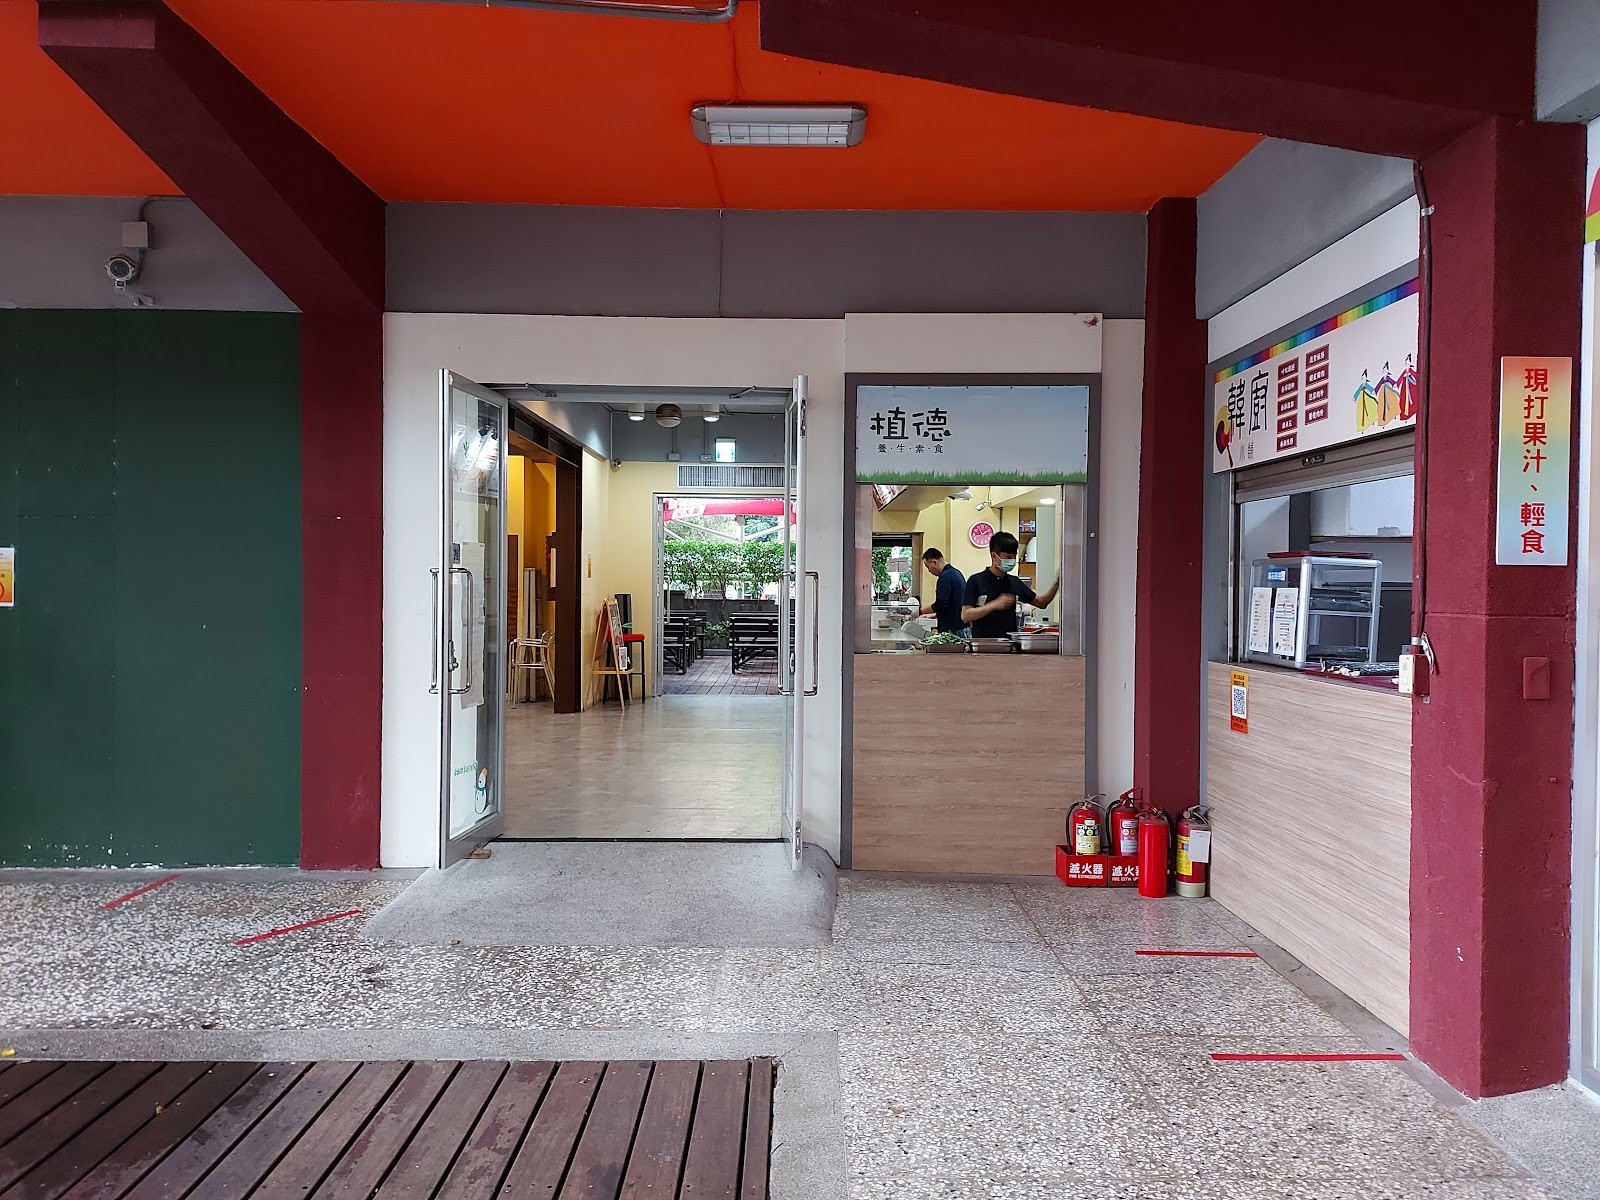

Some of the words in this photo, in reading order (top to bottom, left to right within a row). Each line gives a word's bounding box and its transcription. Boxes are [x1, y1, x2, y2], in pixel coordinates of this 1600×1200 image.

[869, 406, 952, 442] 植德
[1228, 369, 1269, 443] 韓廚
[1520, 368, 1548, 554] 現打果汁、輕食
[1069, 863, 1103, 874] 滅火器
